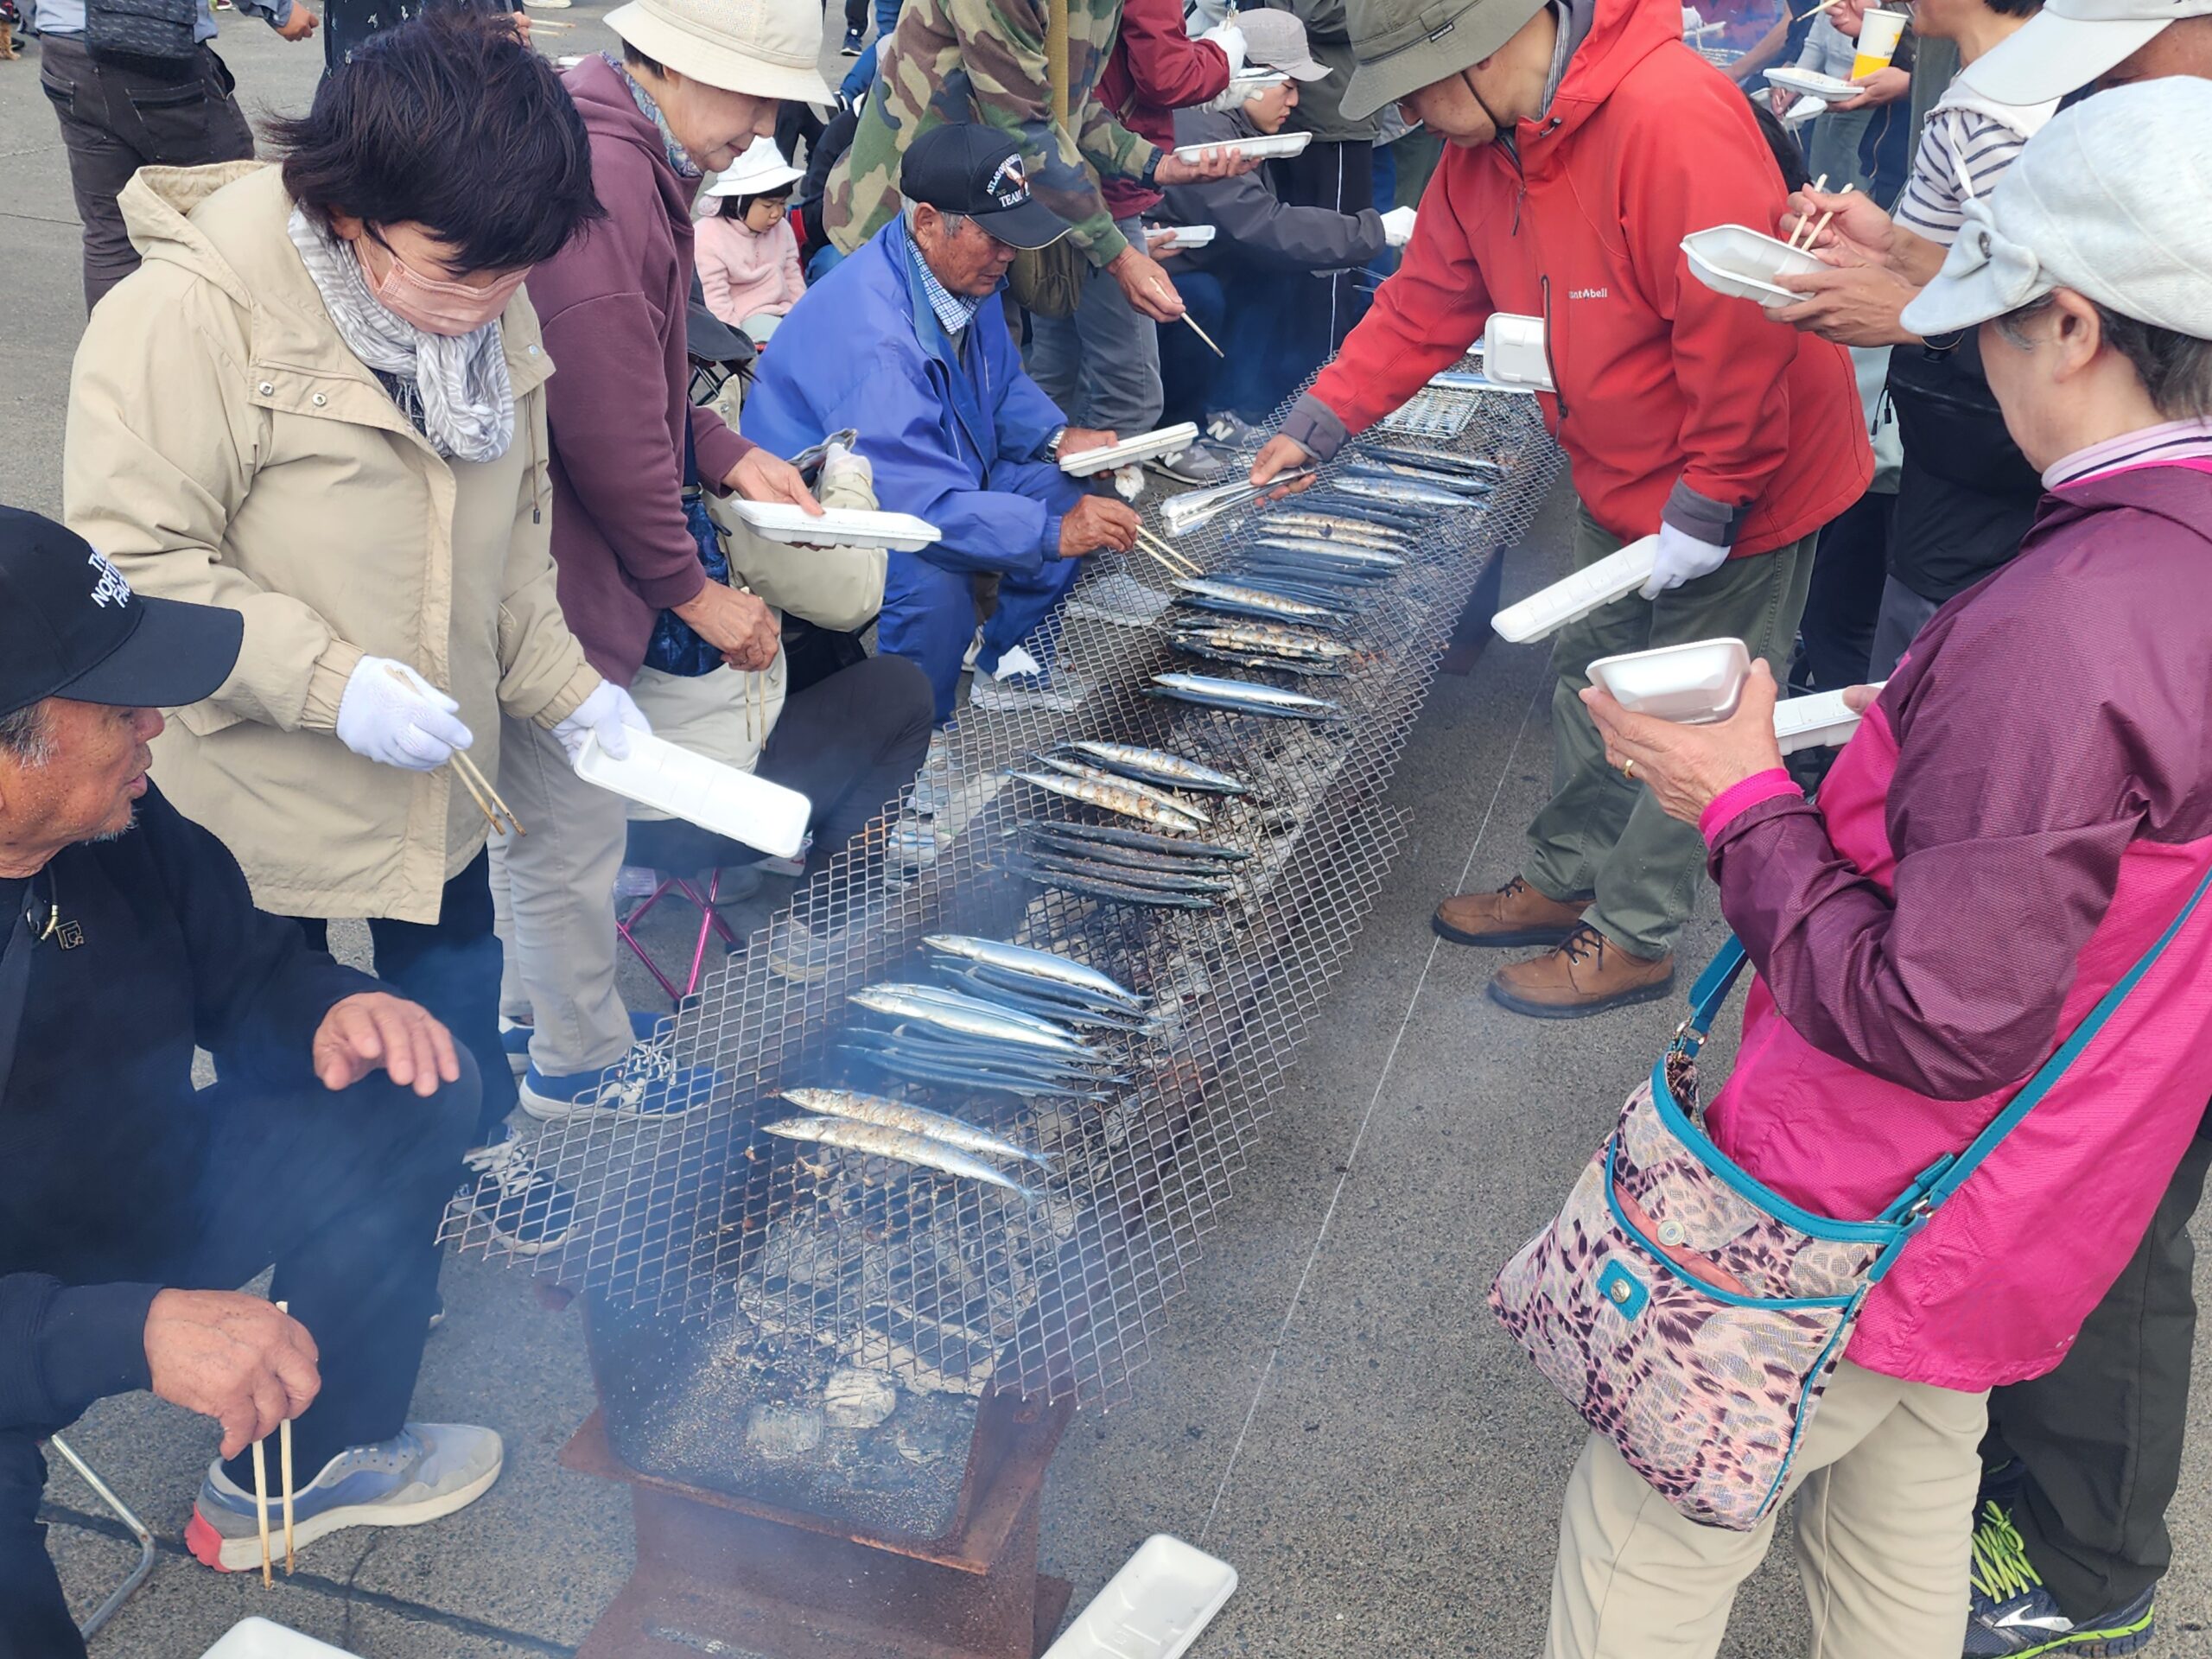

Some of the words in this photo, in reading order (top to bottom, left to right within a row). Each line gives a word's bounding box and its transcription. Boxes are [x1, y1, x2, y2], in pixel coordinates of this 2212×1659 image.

[986, 170, 1002, 196] ATLAS
[999, 189, 1023, 207] TEAM
[88, 552, 106, 573] TH
[112, 576, 130, 608] FAC
